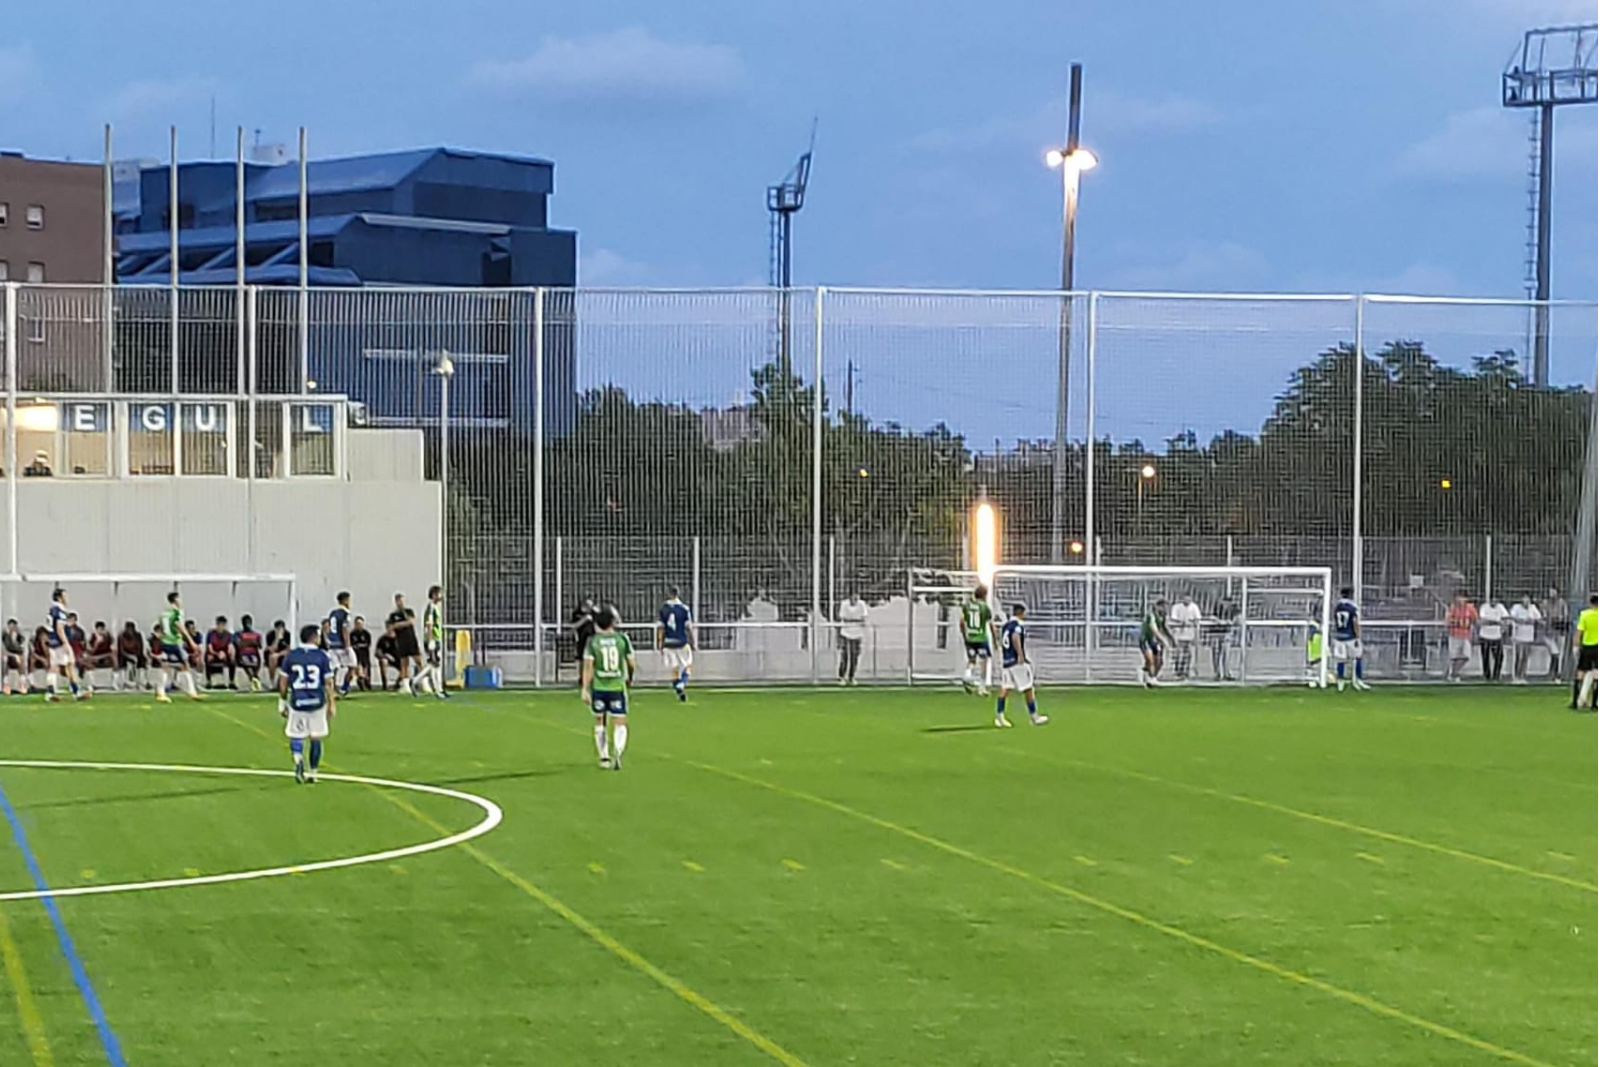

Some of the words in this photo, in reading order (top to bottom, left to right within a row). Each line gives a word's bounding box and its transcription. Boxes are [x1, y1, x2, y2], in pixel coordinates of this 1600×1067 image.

[667, 613, 676, 631] 4
[600, 646, 619, 671] 19
[291, 665, 320, 689] 23
